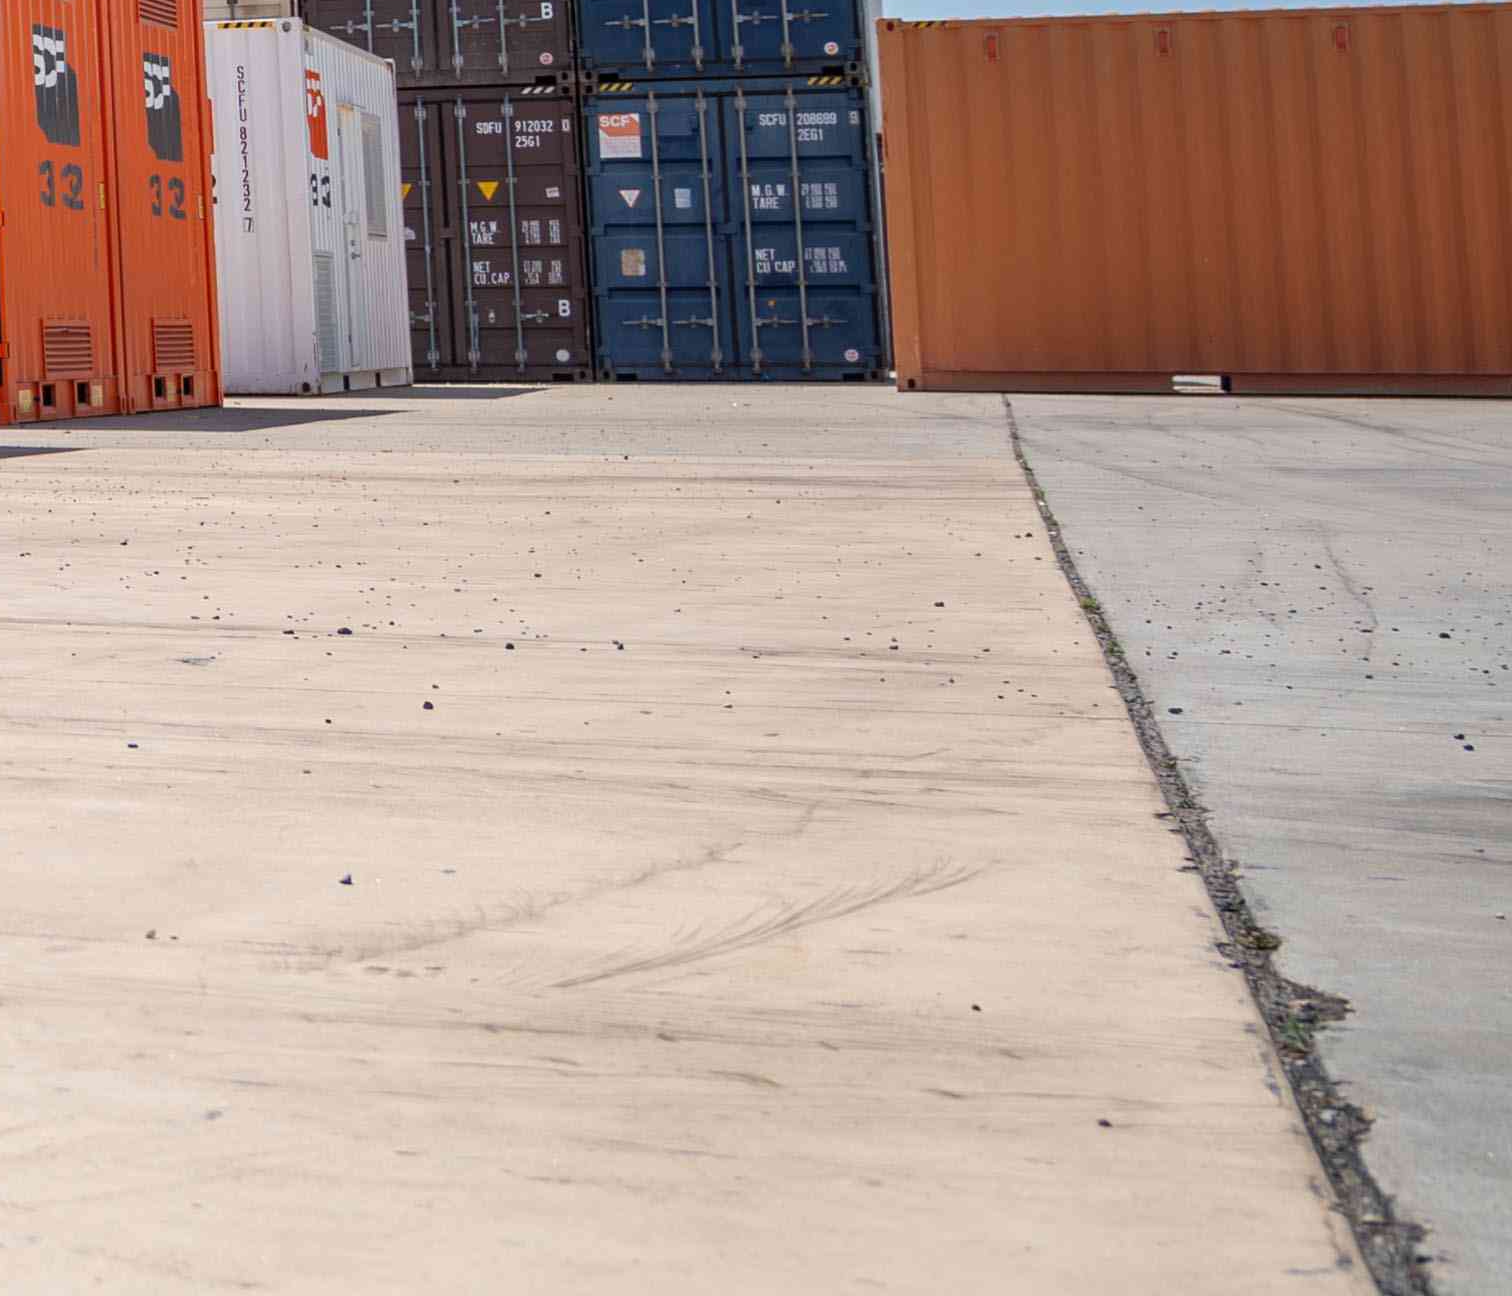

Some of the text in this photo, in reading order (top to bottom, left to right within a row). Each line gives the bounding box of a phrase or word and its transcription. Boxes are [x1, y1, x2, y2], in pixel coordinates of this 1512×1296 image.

[541, 2, 553, 19] B
[599, 115, 630, 128] SCF
[759, 113, 786, 126] SCFU
[514, 120, 552, 132] 912032
[236, 66, 251, 211] SCFU 821232
[797, 128, 823, 141] 2EG1
[515, 136, 540, 148] 25G1
[752, 197, 780, 209] TARE
[471, 233, 495, 245] TARE
[755, 249, 776, 261] NET
[474, 261, 491, 272] NET
[558, 300, 570, 316] B
